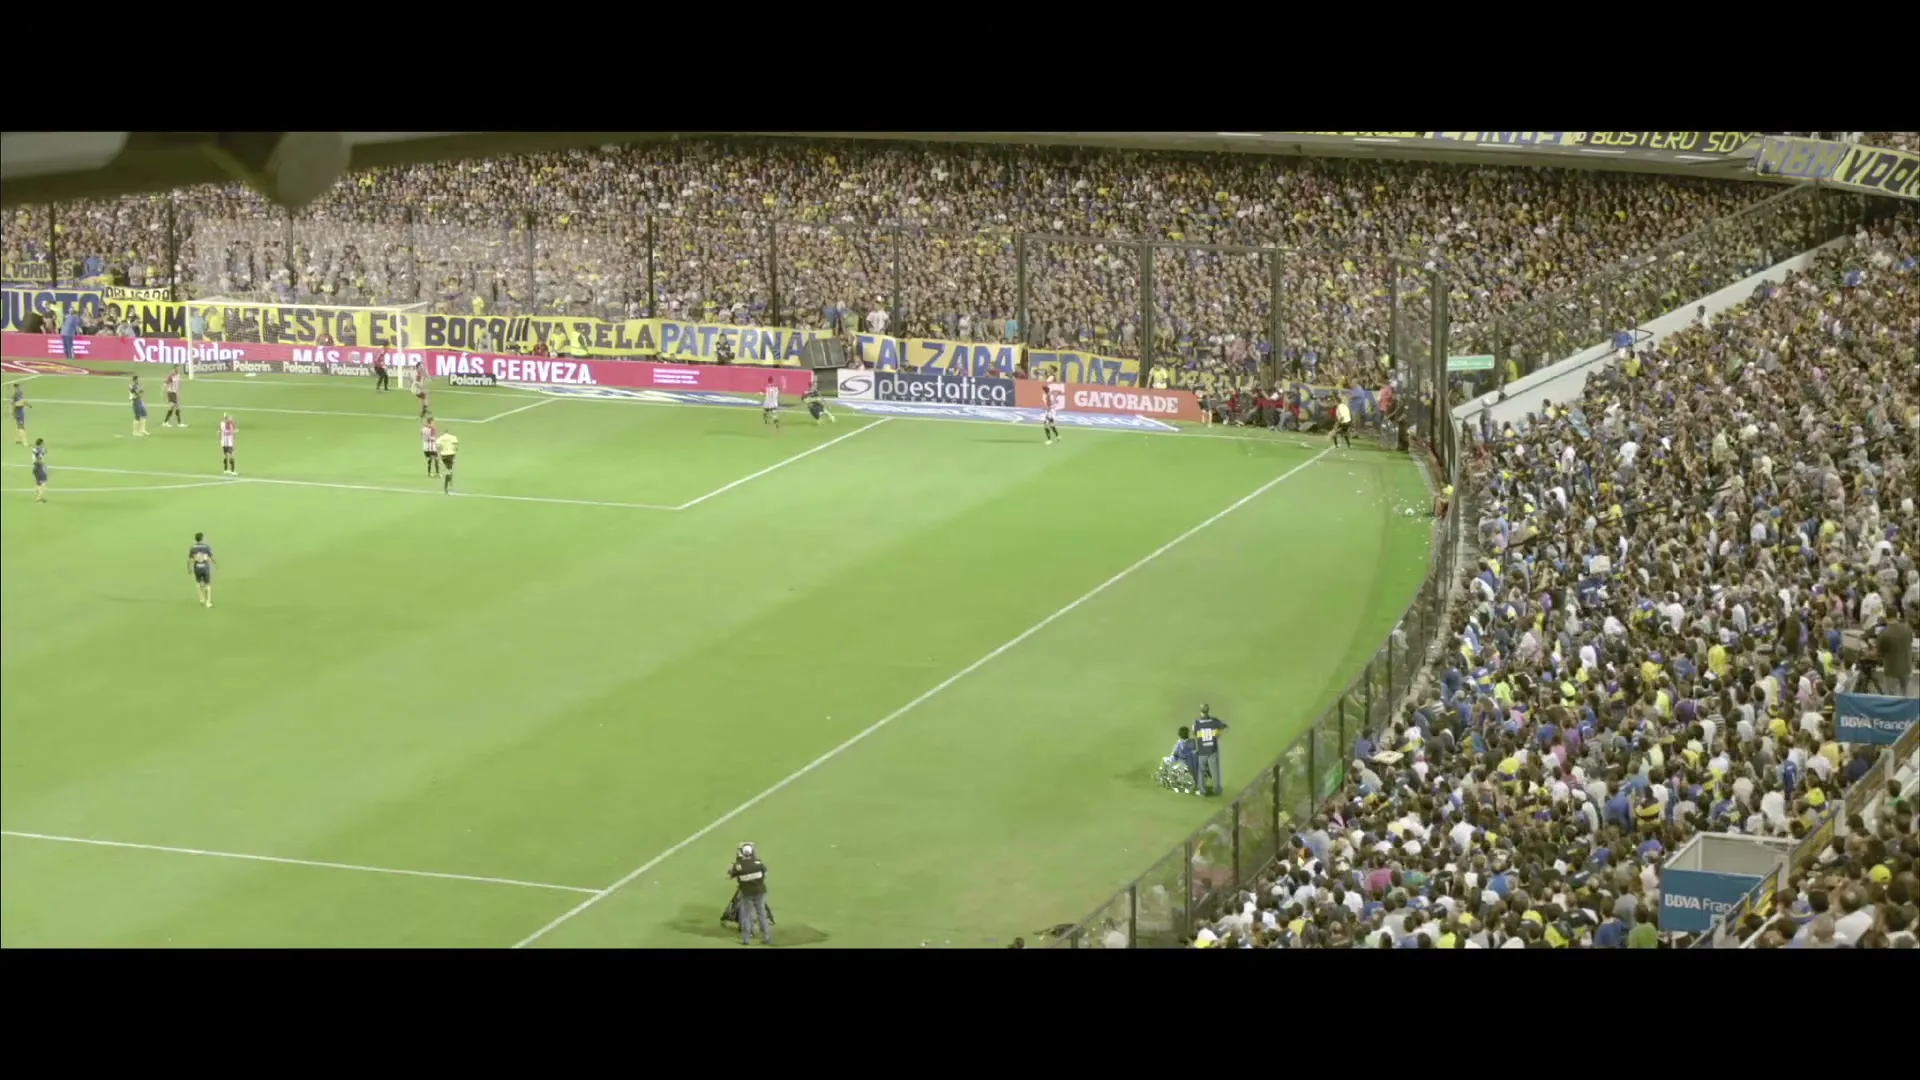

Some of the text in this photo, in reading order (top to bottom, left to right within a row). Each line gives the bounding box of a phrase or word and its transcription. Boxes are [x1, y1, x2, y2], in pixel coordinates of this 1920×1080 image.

[449, 374, 493, 387] Polacrin
[492, 358, 598, 385] CERVEZA.
[878, 374, 1007, 401] pbestatica
[1074, 390, 1179, 414] GATORADE
[1840, 715, 1872, 729] BBVA
[1664, 893, 1701, 911] BBVA
